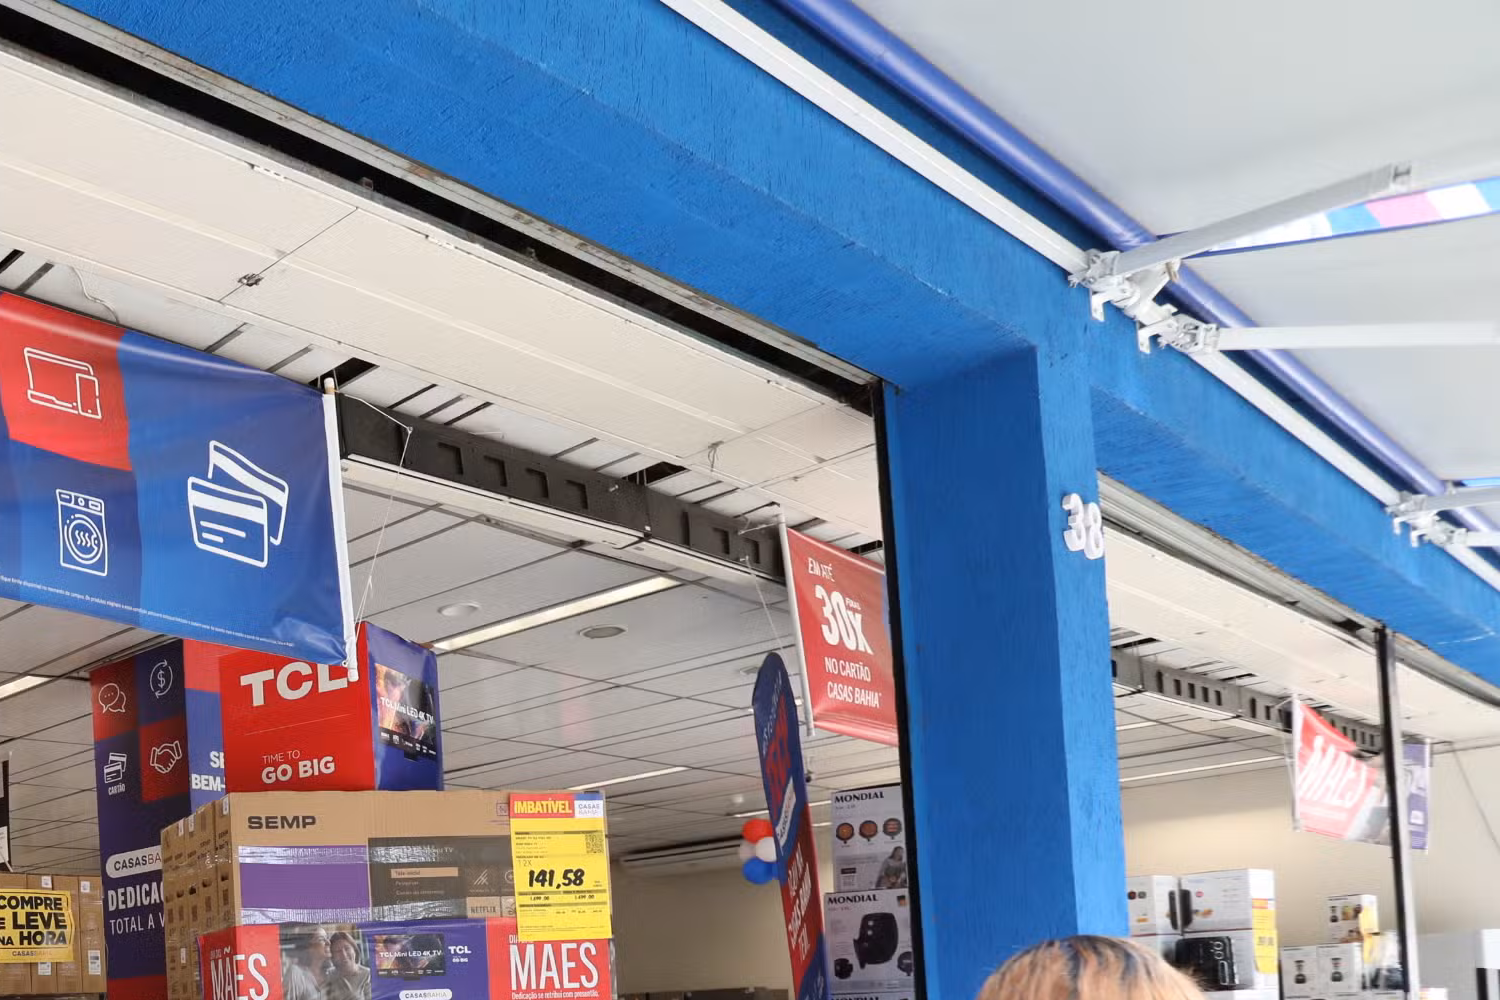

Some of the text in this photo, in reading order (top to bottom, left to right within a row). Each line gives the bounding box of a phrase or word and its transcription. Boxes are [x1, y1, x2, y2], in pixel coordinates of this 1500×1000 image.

[1062, 493, 1104, 559] 38
[808, 557, 820, 577] EM
[825, 657, 871, 682] NO CARTÃO
[240, 661, 348, 707] TCL
[827, 681, 853, 703] CASAS
[262, 750, 300, 765] TIME TO
[261, 756, 336, 784] GO BIG
[108, 783, 126, 795] CARTÃO
[191, 773, 225, 791] BEM-
[514, 798, 573, 814] IMBATÍVEL
[834, 791, 884, 804] MONDIAL
[247, 815, 317, 829] SEMP
[114, 853, 162, 871] CASASBA
[528, 868, 585, 889] 141,58
[108, 881, 164, 912] DEDICA
[827, 893, 878, 905] MONDIAL
[12, 911, 68, 930] LEVE
[110, 914, 157, 936] TOTAL A
[19, 931, 67, 945] HORA
[449, 945, 471, 954] TCL
[404, 991, 447, 999] CASASBAHIA
[512, 991, 537, 1000] Dedicação
